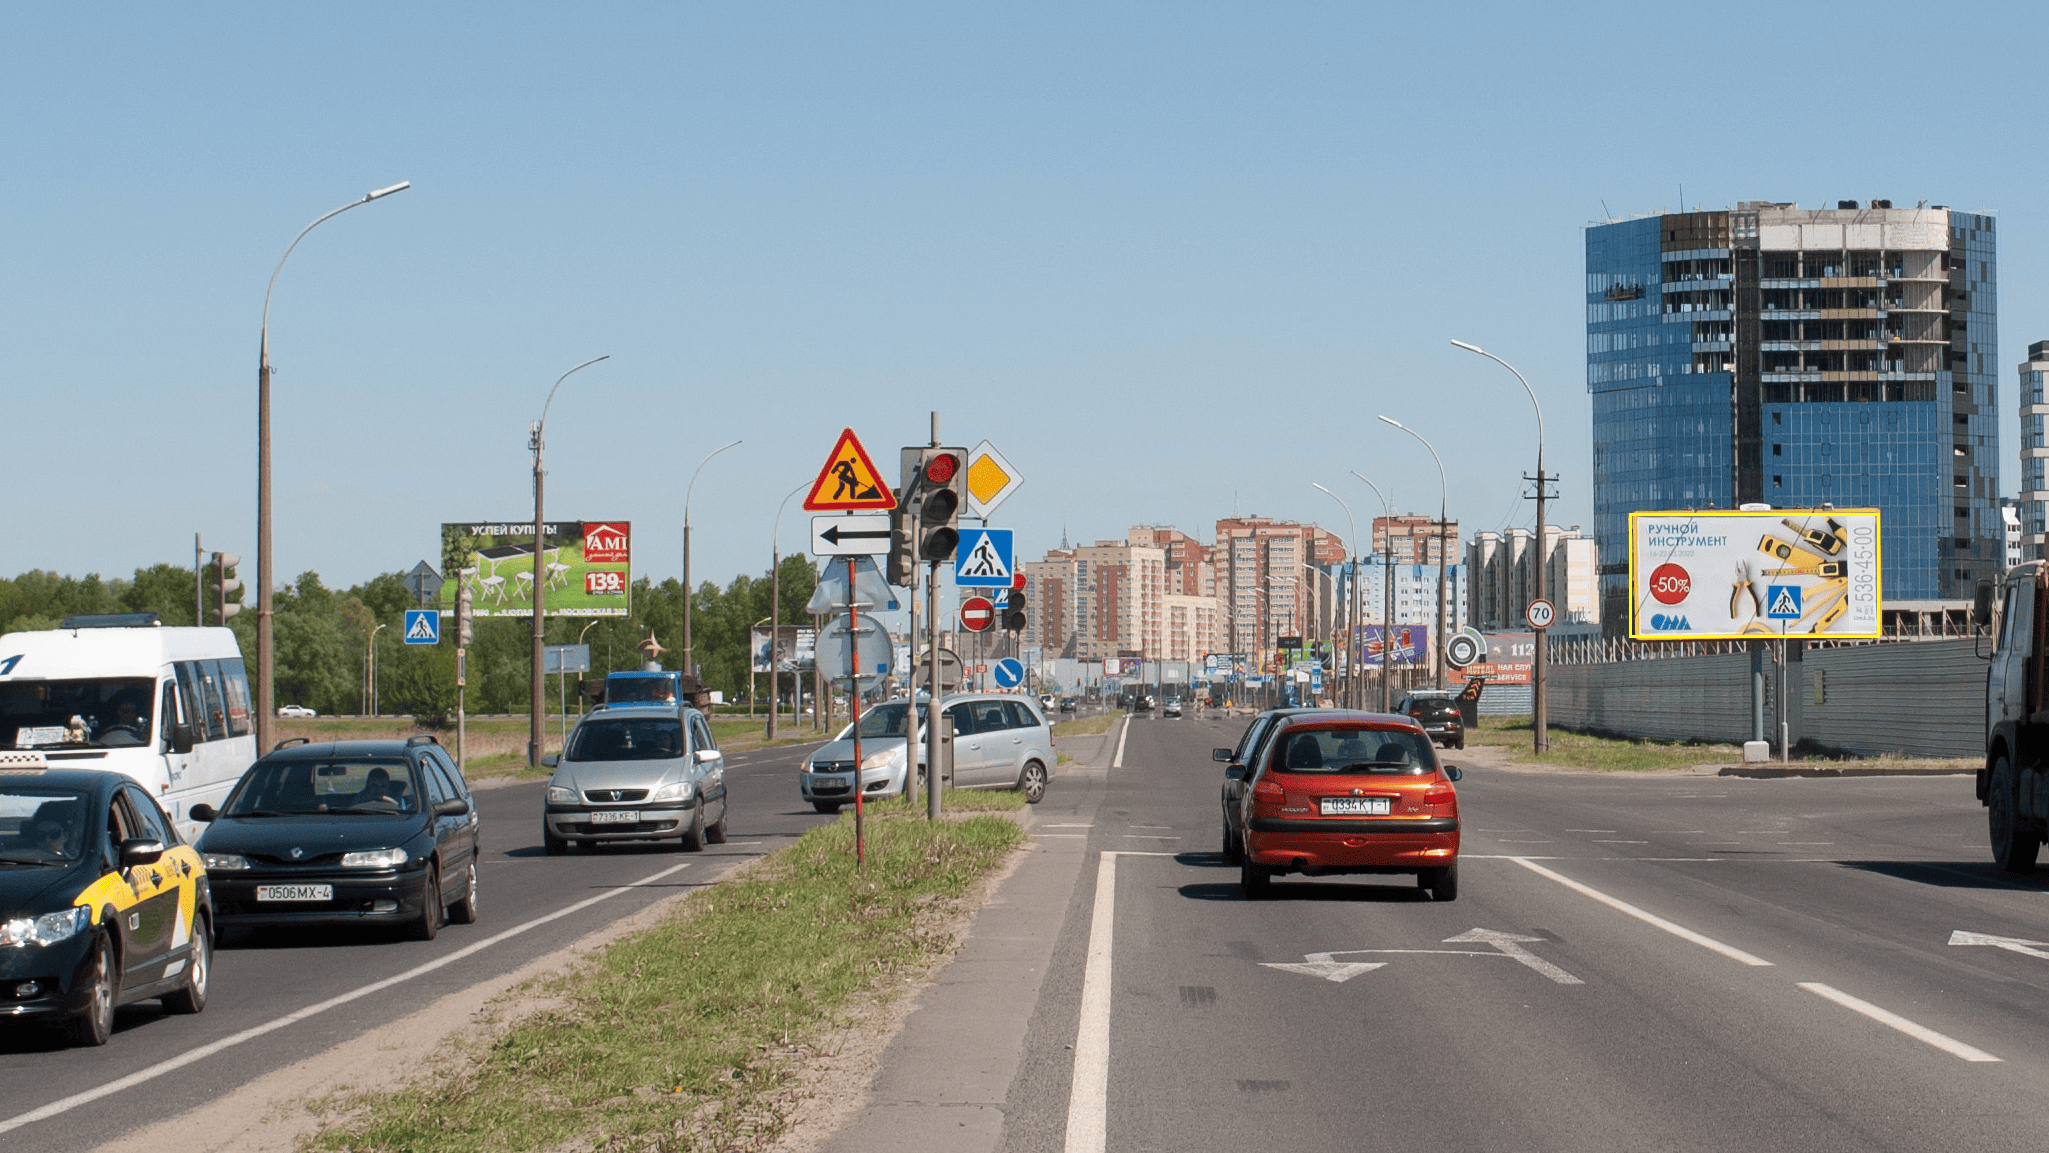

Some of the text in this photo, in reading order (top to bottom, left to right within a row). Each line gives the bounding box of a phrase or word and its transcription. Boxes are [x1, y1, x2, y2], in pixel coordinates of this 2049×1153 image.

[472, 524, 508, 535] УСПЕЙ
[1648, 522, 1698, 534] РУЧНОЙ
[1648, 536, 1727, 547] ИНСТРУМЕНТ
[1651, 576, 1690, 593] -50%
[1533, 607, 1550, 620] 70
